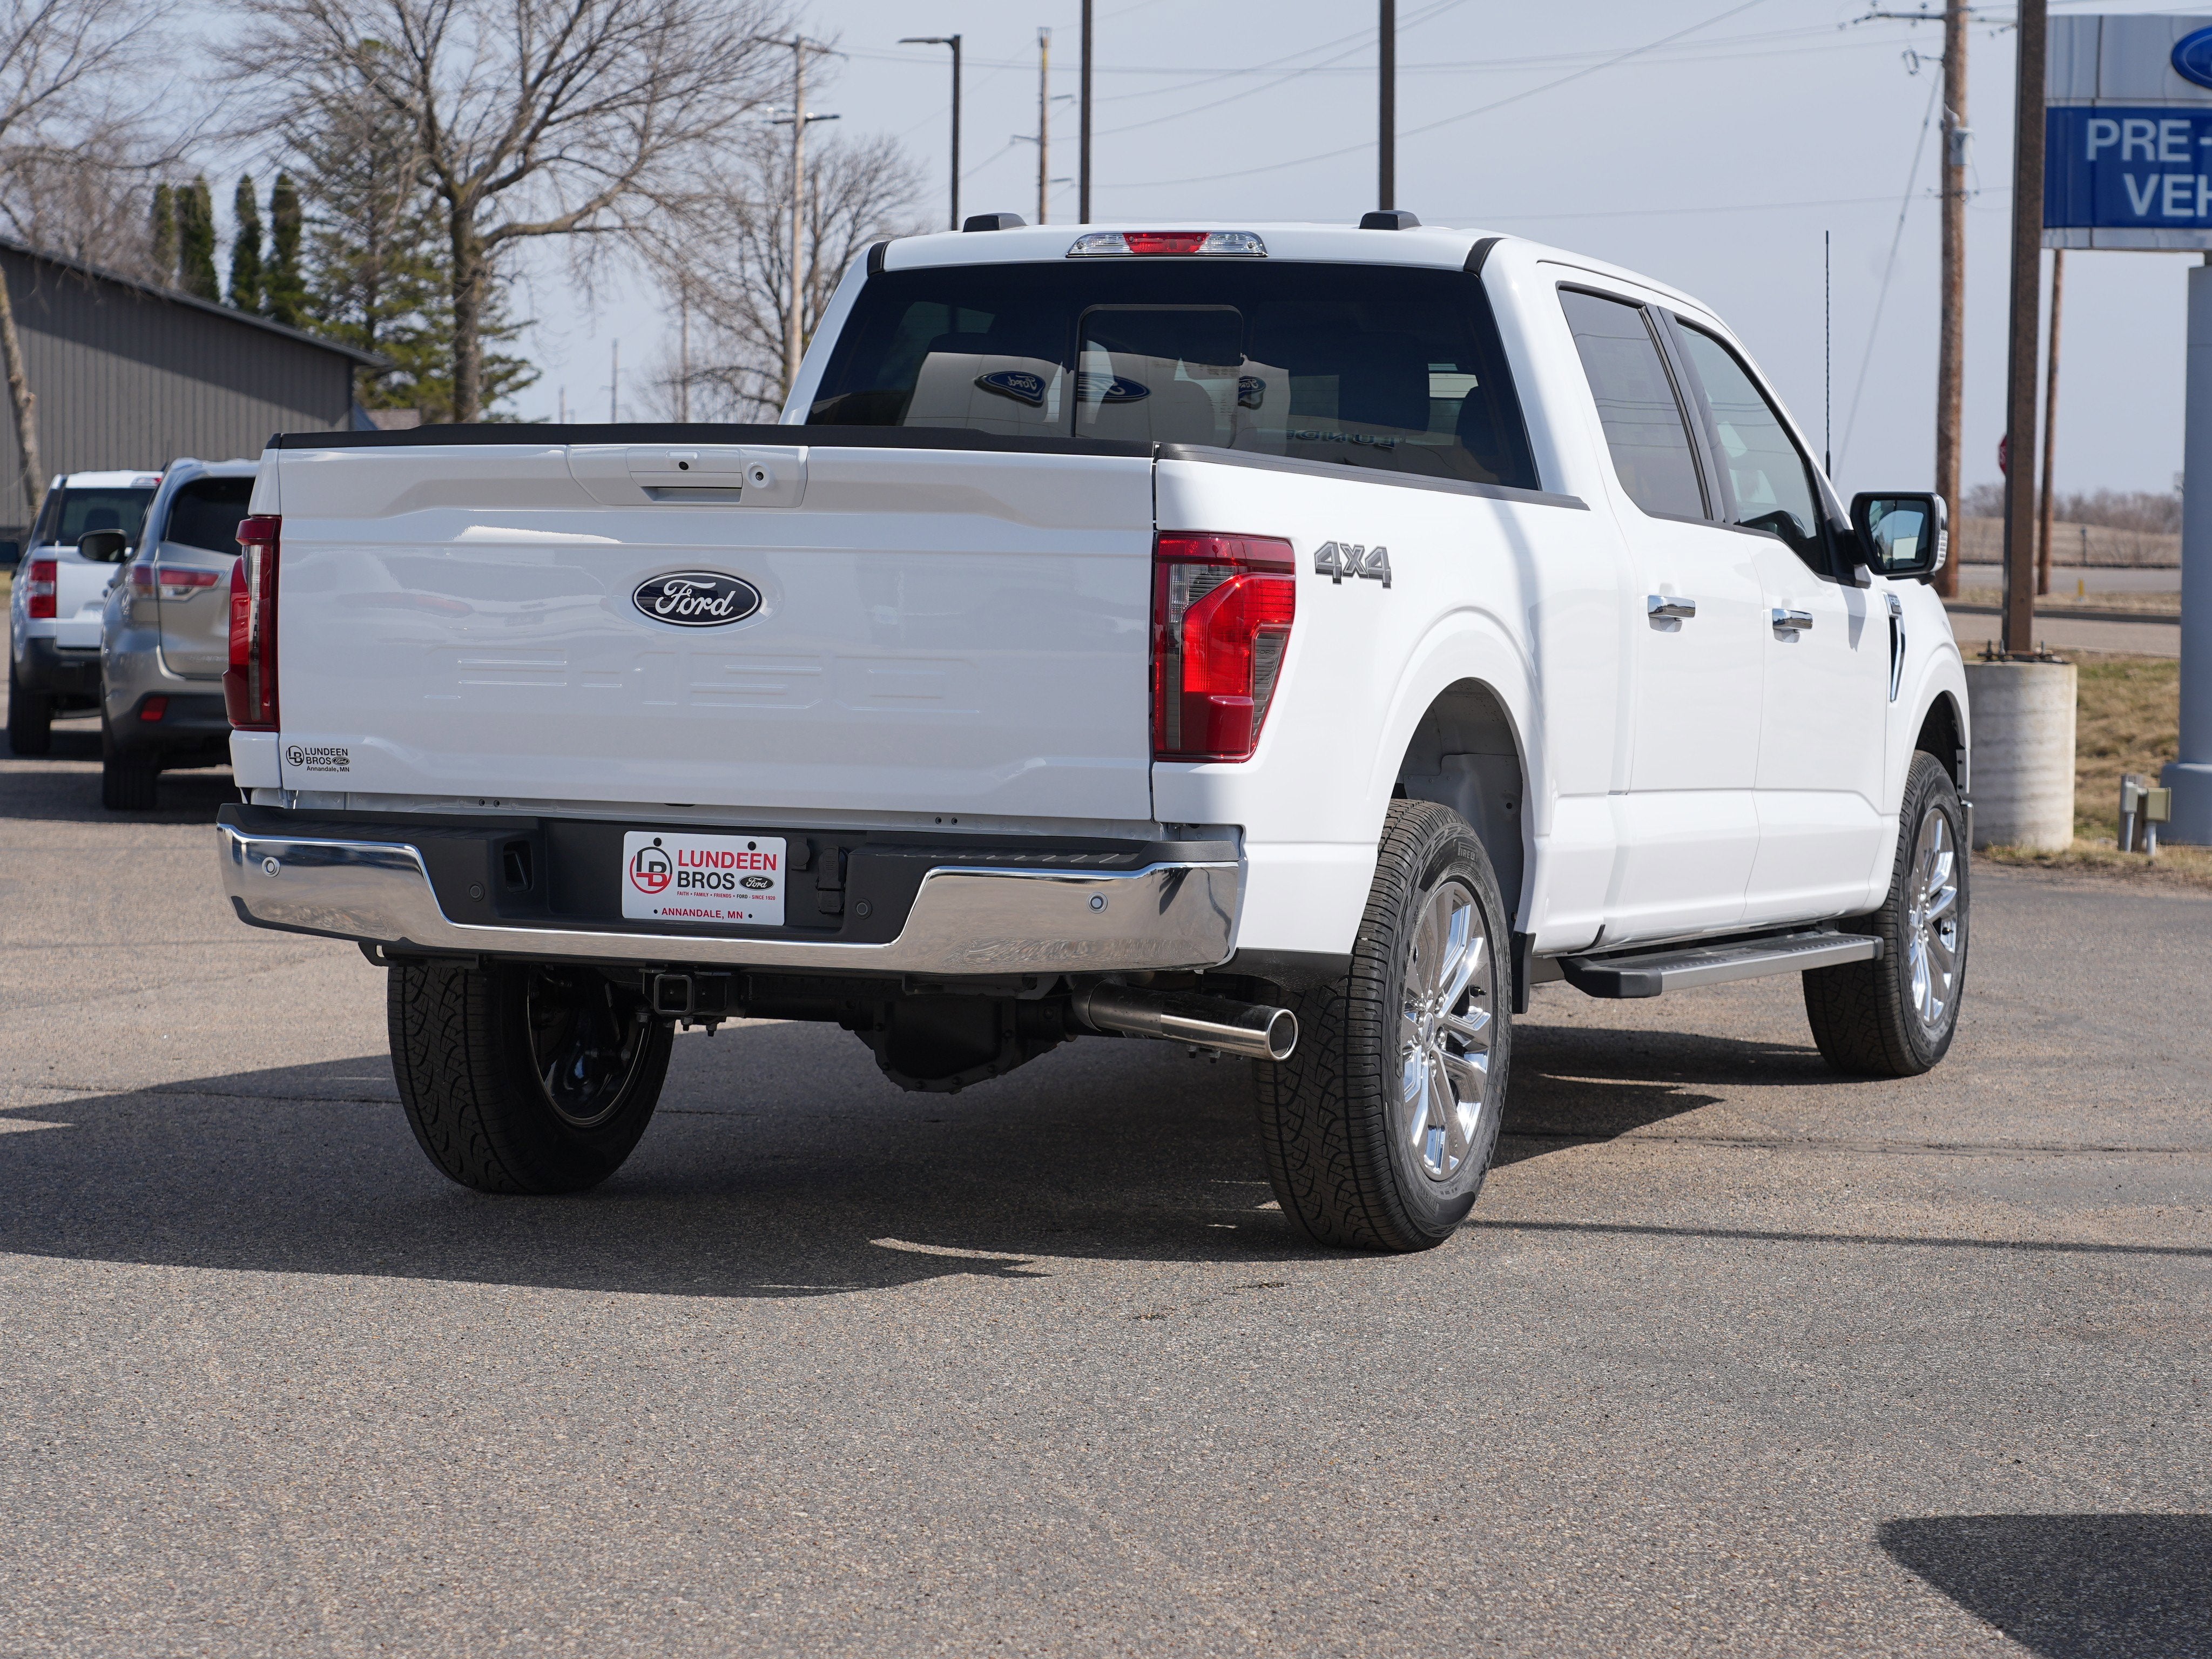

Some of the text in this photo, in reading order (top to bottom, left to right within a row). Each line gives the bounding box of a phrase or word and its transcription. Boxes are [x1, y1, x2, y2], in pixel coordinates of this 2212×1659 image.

[655, 579, 736, 616] Ford
[305, 747, 348, 756] LUNDEEN
[306, 757, 332, 765] BROS
[678, 849, 777, 871] LUNDEEN
[677, 871, 735, 890] BROS
[662, 907, 743, 920] ANNANDALE, MN
